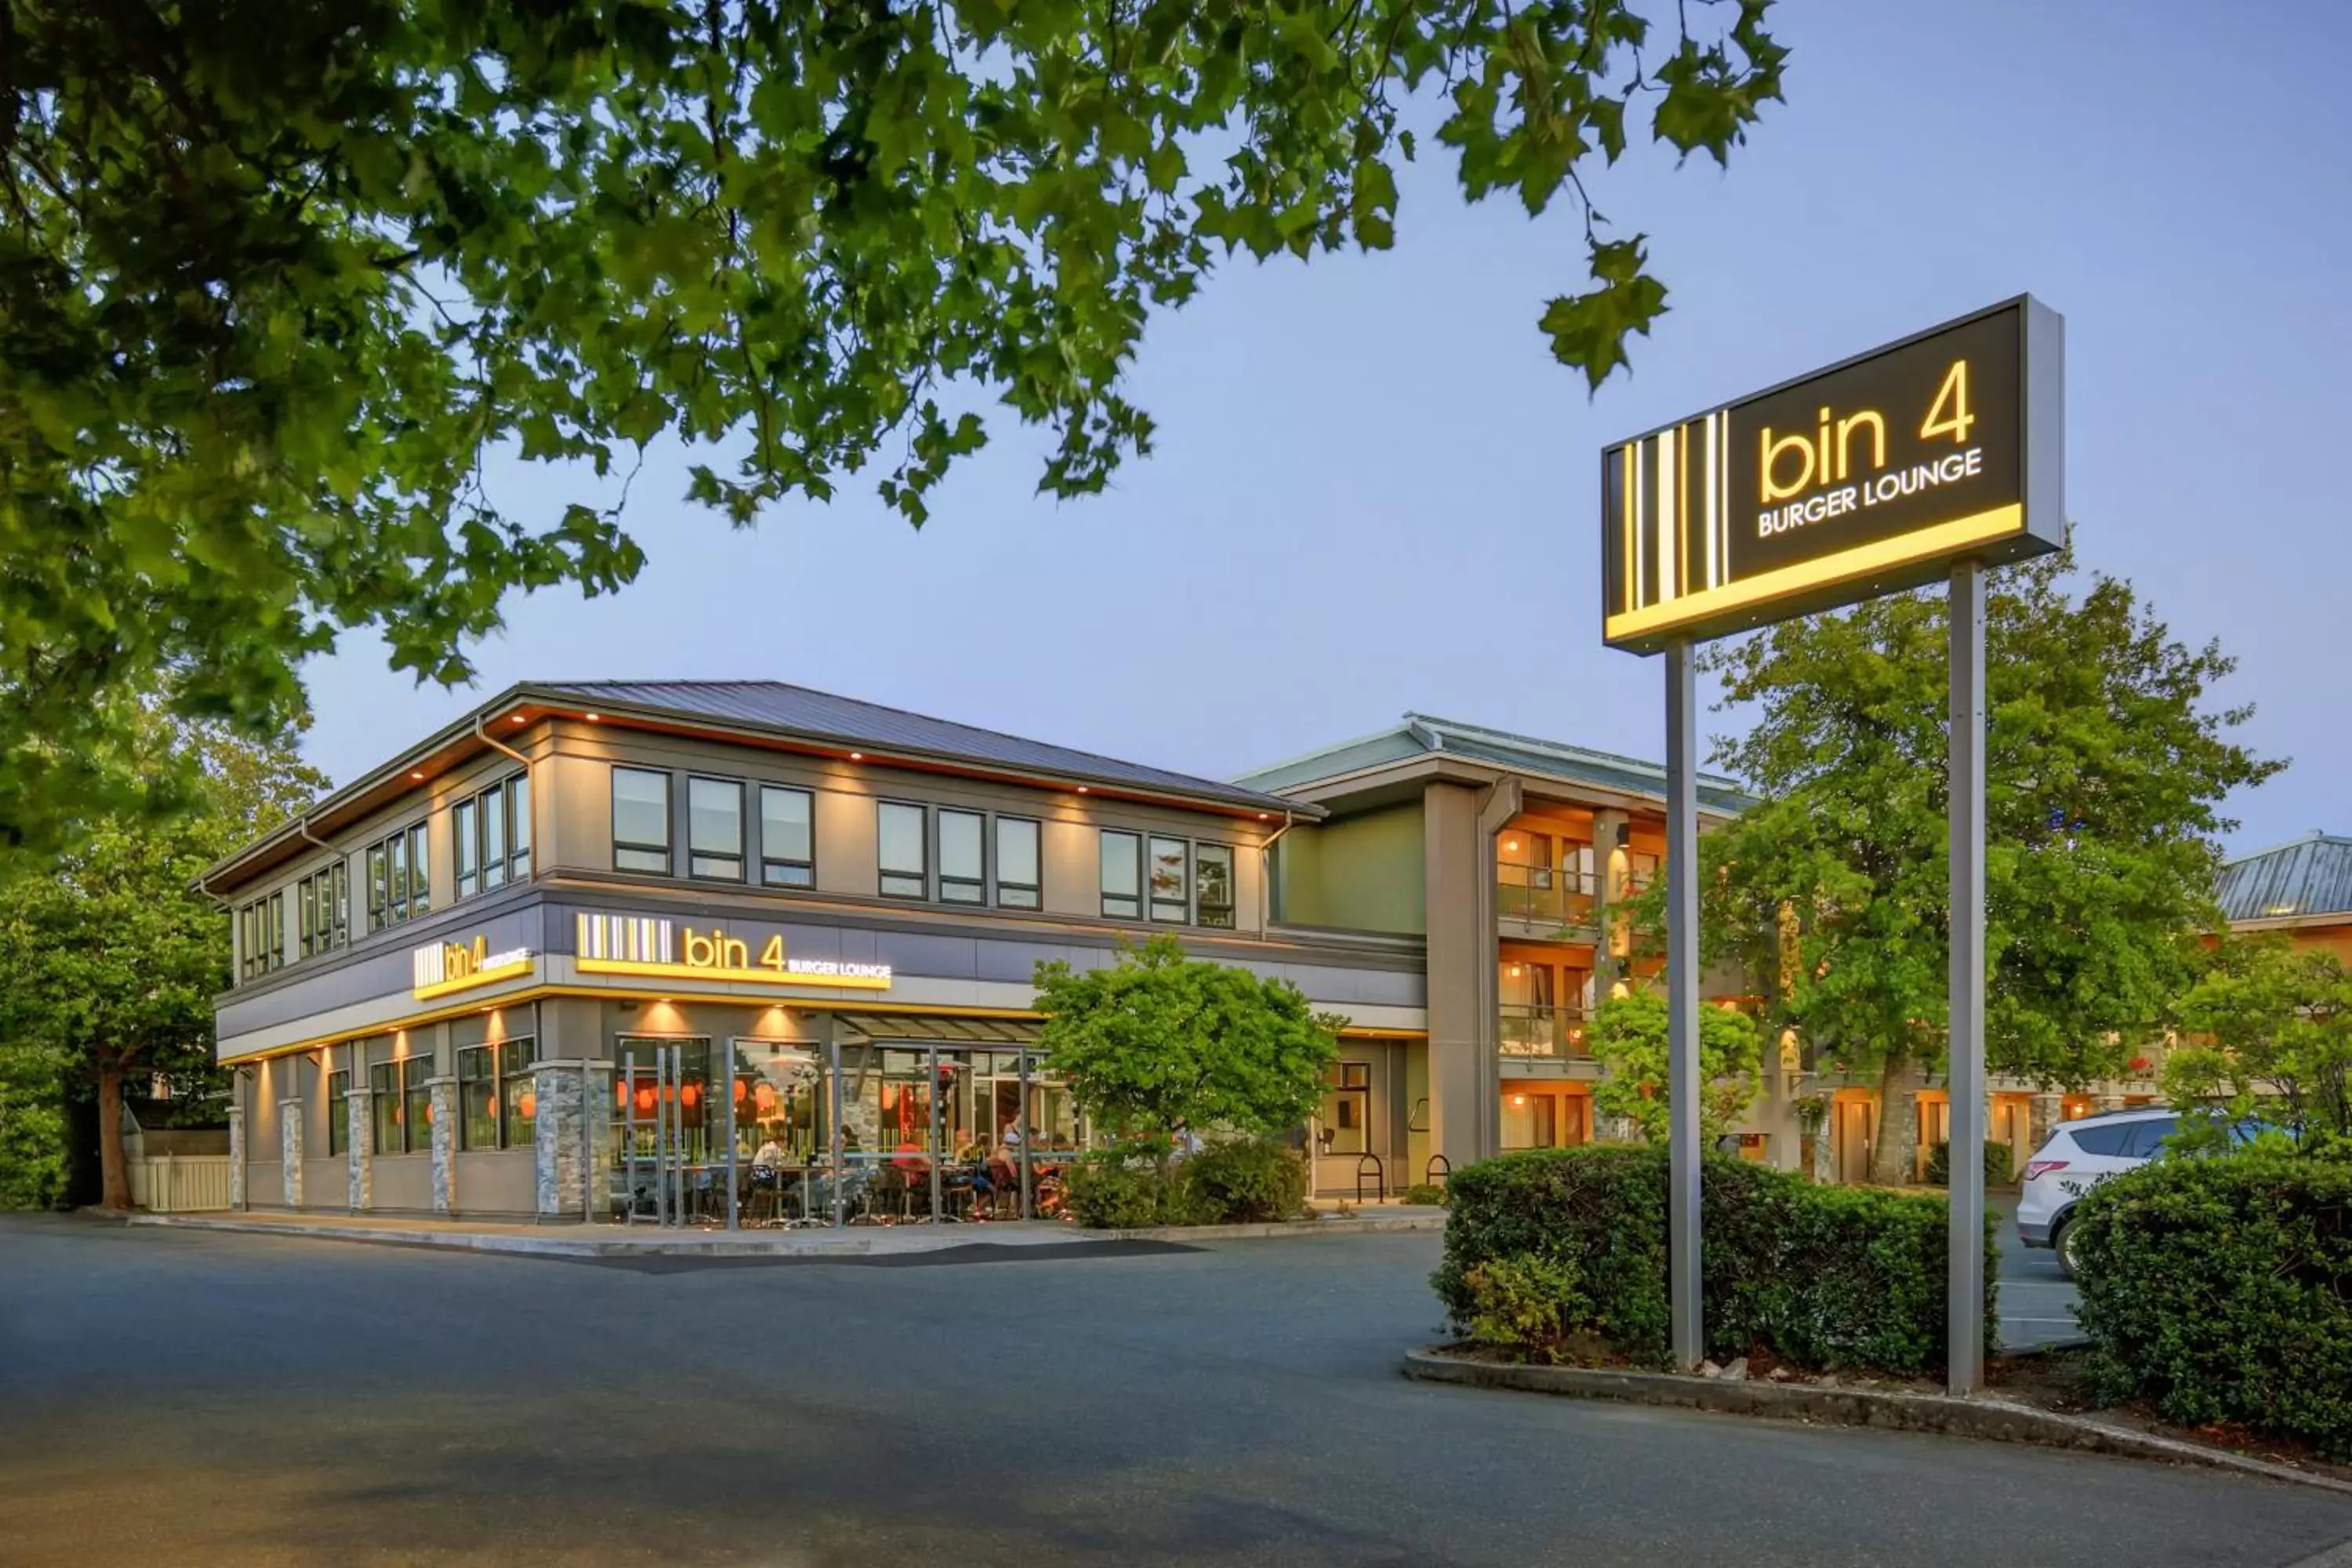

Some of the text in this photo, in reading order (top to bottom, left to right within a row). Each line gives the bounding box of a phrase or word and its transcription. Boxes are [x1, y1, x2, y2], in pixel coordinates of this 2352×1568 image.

[1761, 359, 1975, 503] bin 4
[1759, 447, 1982, 538] BURGER LOUNGE
[445, 942, 468, 982] bin
[472, 935, 485, 973] 4
[683, 927, 891, 979] bin 4 BURGER LOUNGE
